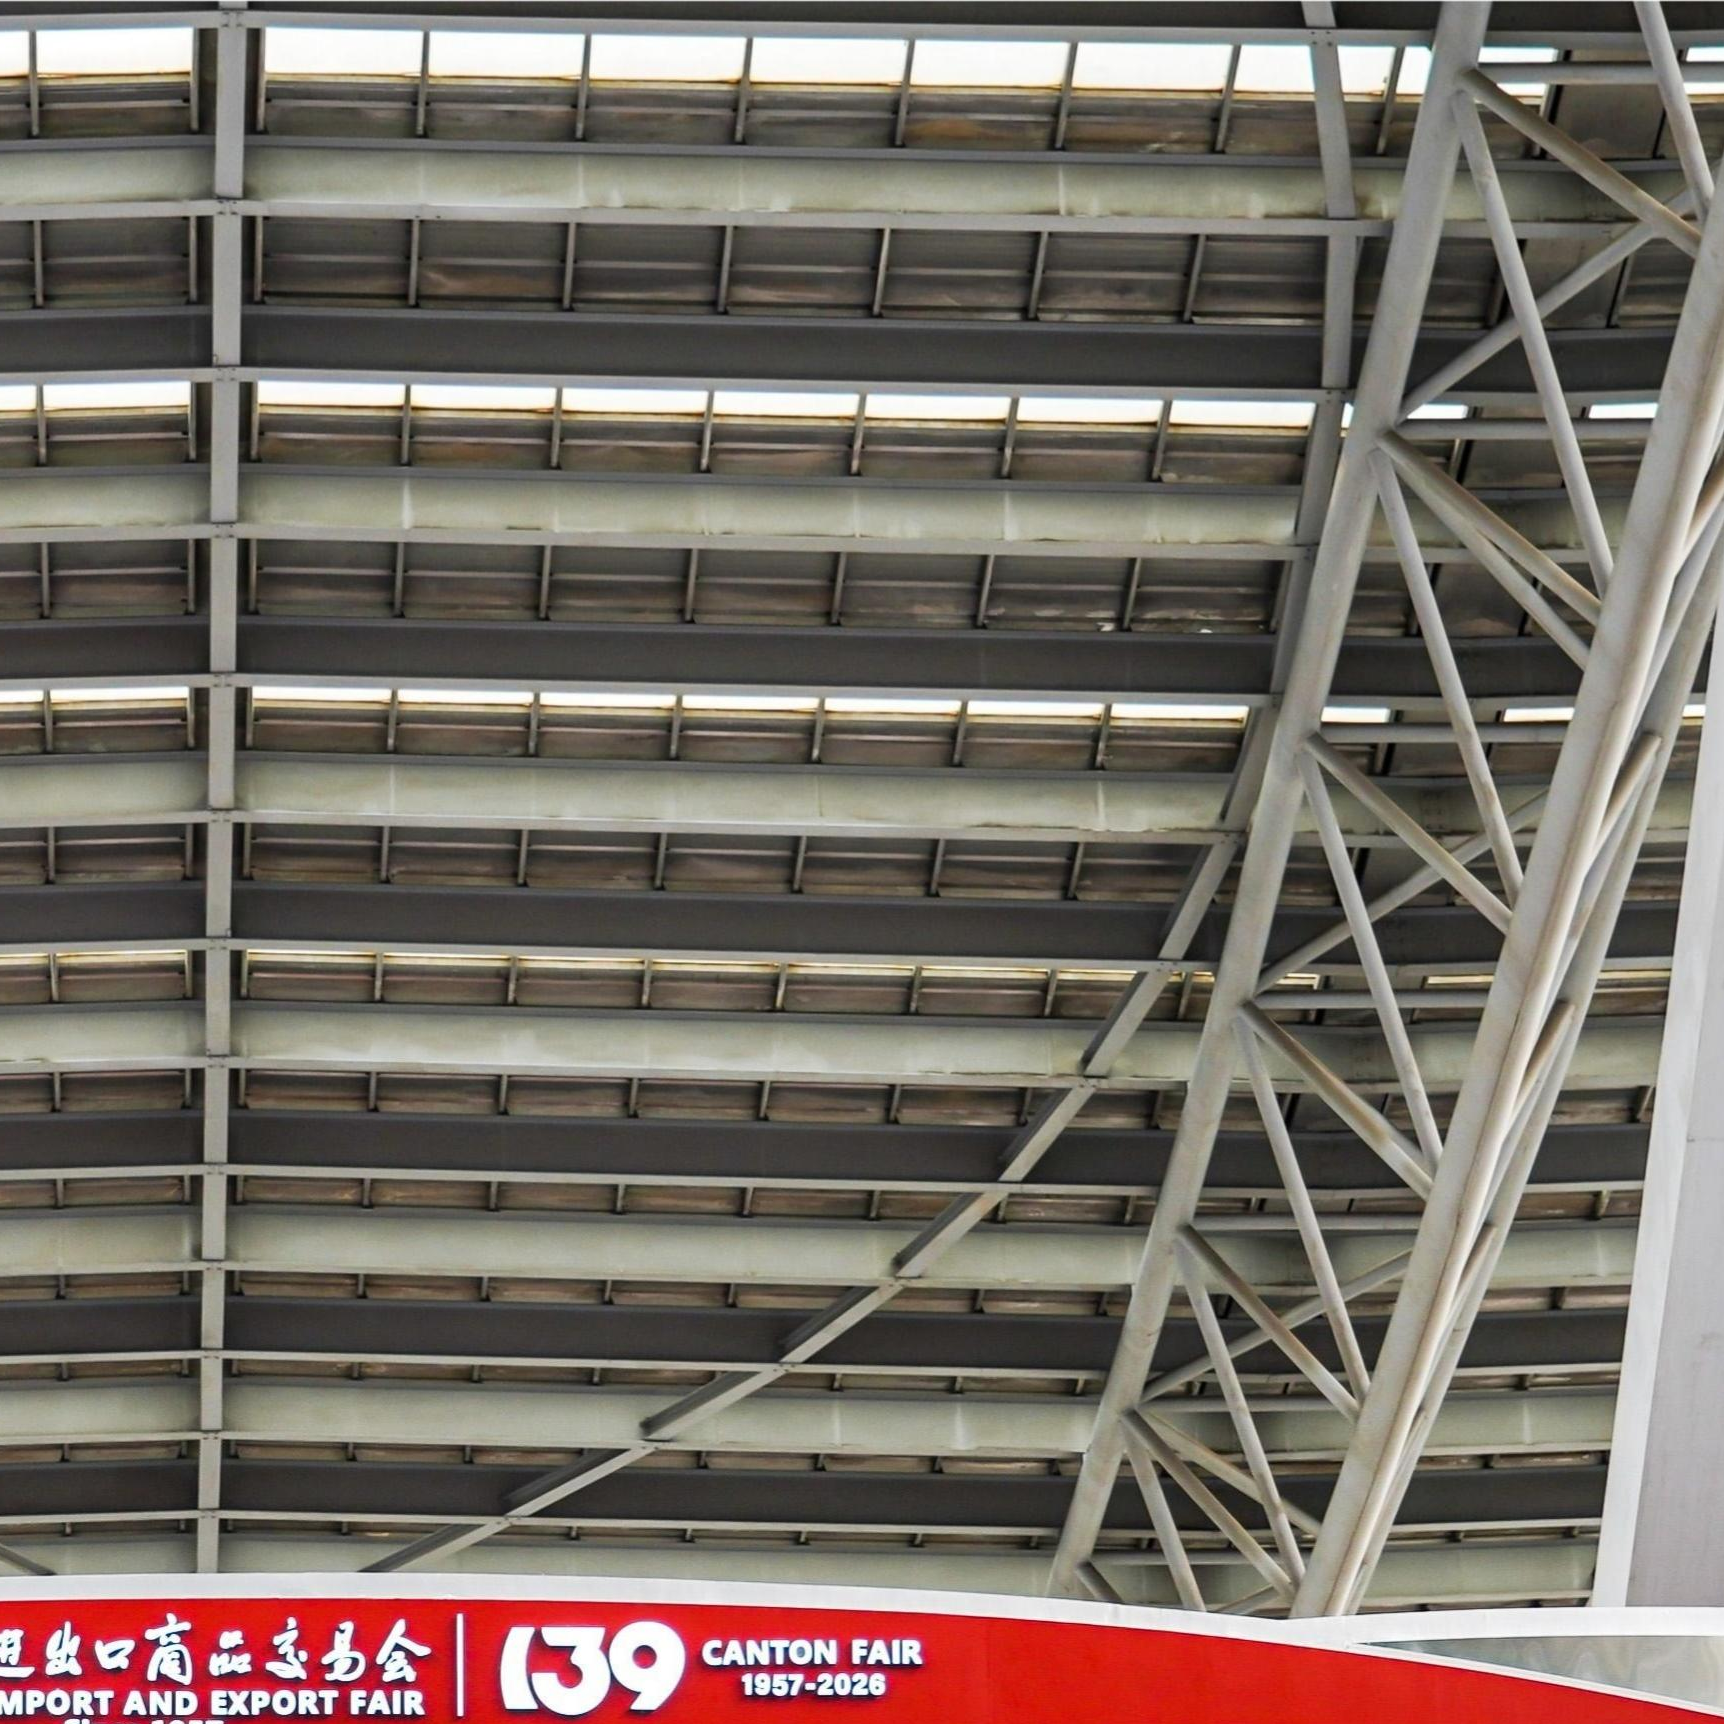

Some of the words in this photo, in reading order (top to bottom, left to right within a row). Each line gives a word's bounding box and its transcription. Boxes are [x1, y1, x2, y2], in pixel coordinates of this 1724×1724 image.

[702, 1640, 837, 1666] CANTON
[852, 1639, 922, 1665] FAIR
[500, 1621, 685, 1716] 139
[741, 1673, 885, 1697] 1957-2026
[123, 1690, 198, 1715] AND
[211, 1690, 339, 1715] EXPORT
[350, 1690, 425, 1715] FAIR
